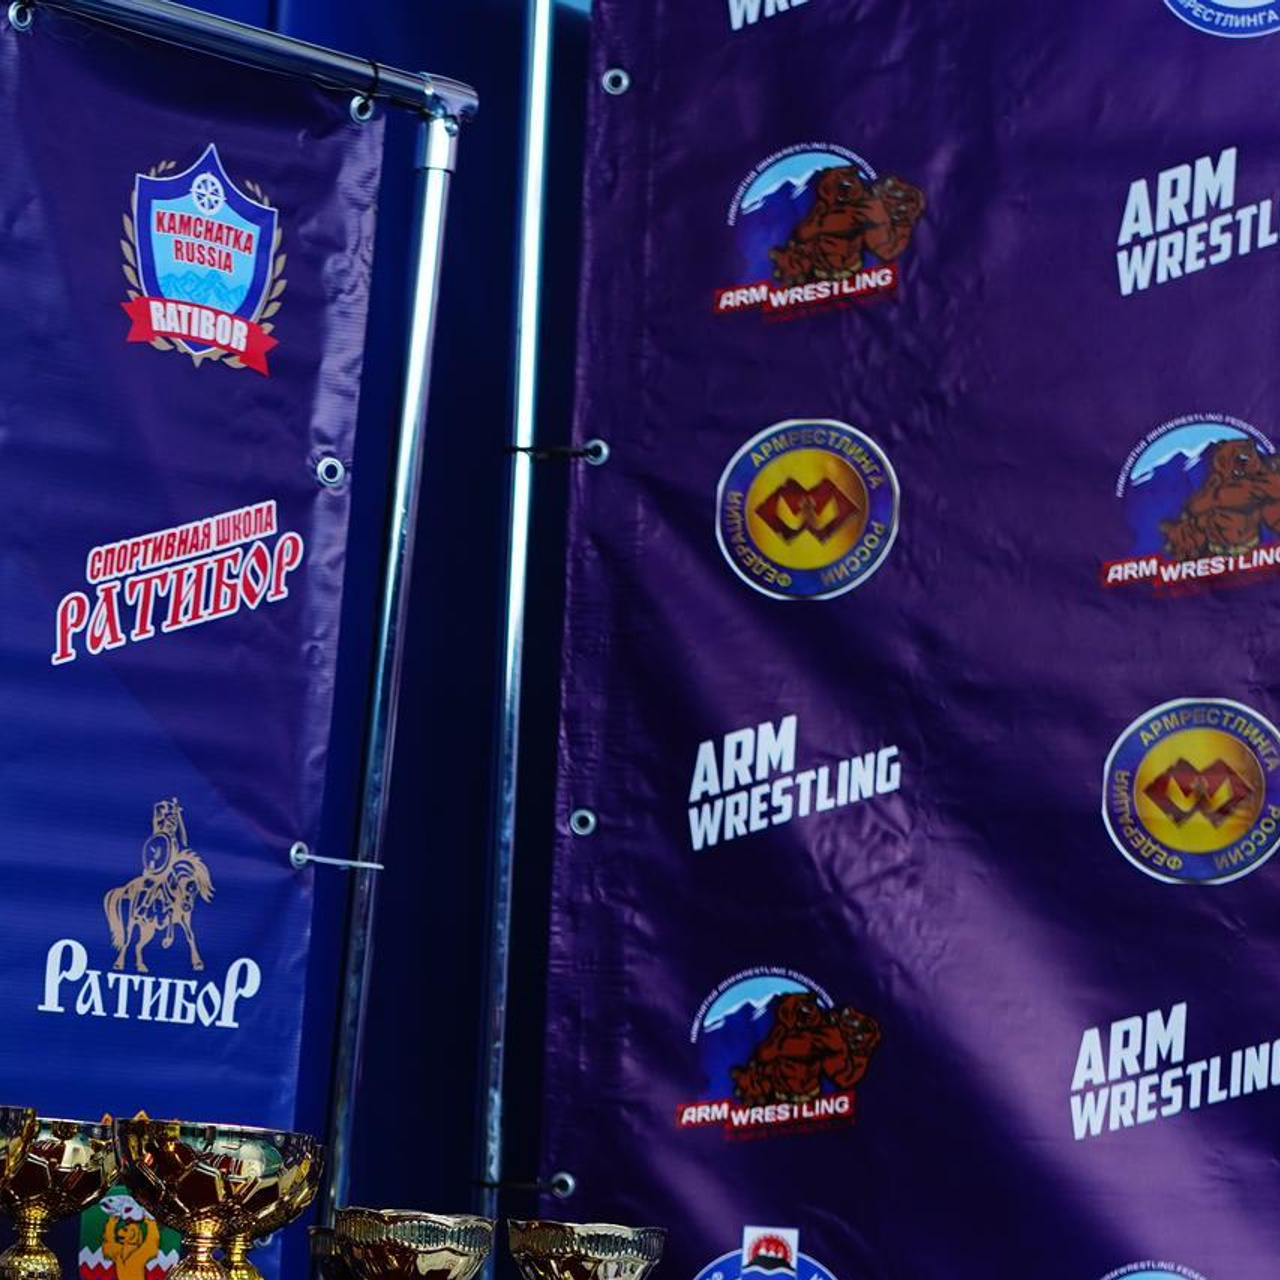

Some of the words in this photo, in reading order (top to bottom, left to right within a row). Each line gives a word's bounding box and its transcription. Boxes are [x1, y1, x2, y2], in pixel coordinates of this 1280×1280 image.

[1177, 0, 1280, 28] ЕСТЛИНГА
[1117, 147, 1237, 247] ARM
[155, 210, 254, 255] KAMCHATKA
[174, 239, 234, 273] RUSSIA
[719, 284, 769, 310] ARM
[769, 268, 894, 308] WRESTLING
[149, 300, 249, 352] RATIBOR
[88, 520, 212, 581] СПОРТИВНАЯ
[215, 502, 275, 546] ШКОЛА
[1106, 558, 1159, 583] ARM
[53, 533, 302, 664] РАТИБОР
[688, 713, 798, 804] ARM
[688, 744, 902, 852] WRESTLING
[1070, 1001, 1187, 1092] ARM
[680, 1101, 729, 1125] ARM
[731, 1096, 850, 1127] WRESTLING
